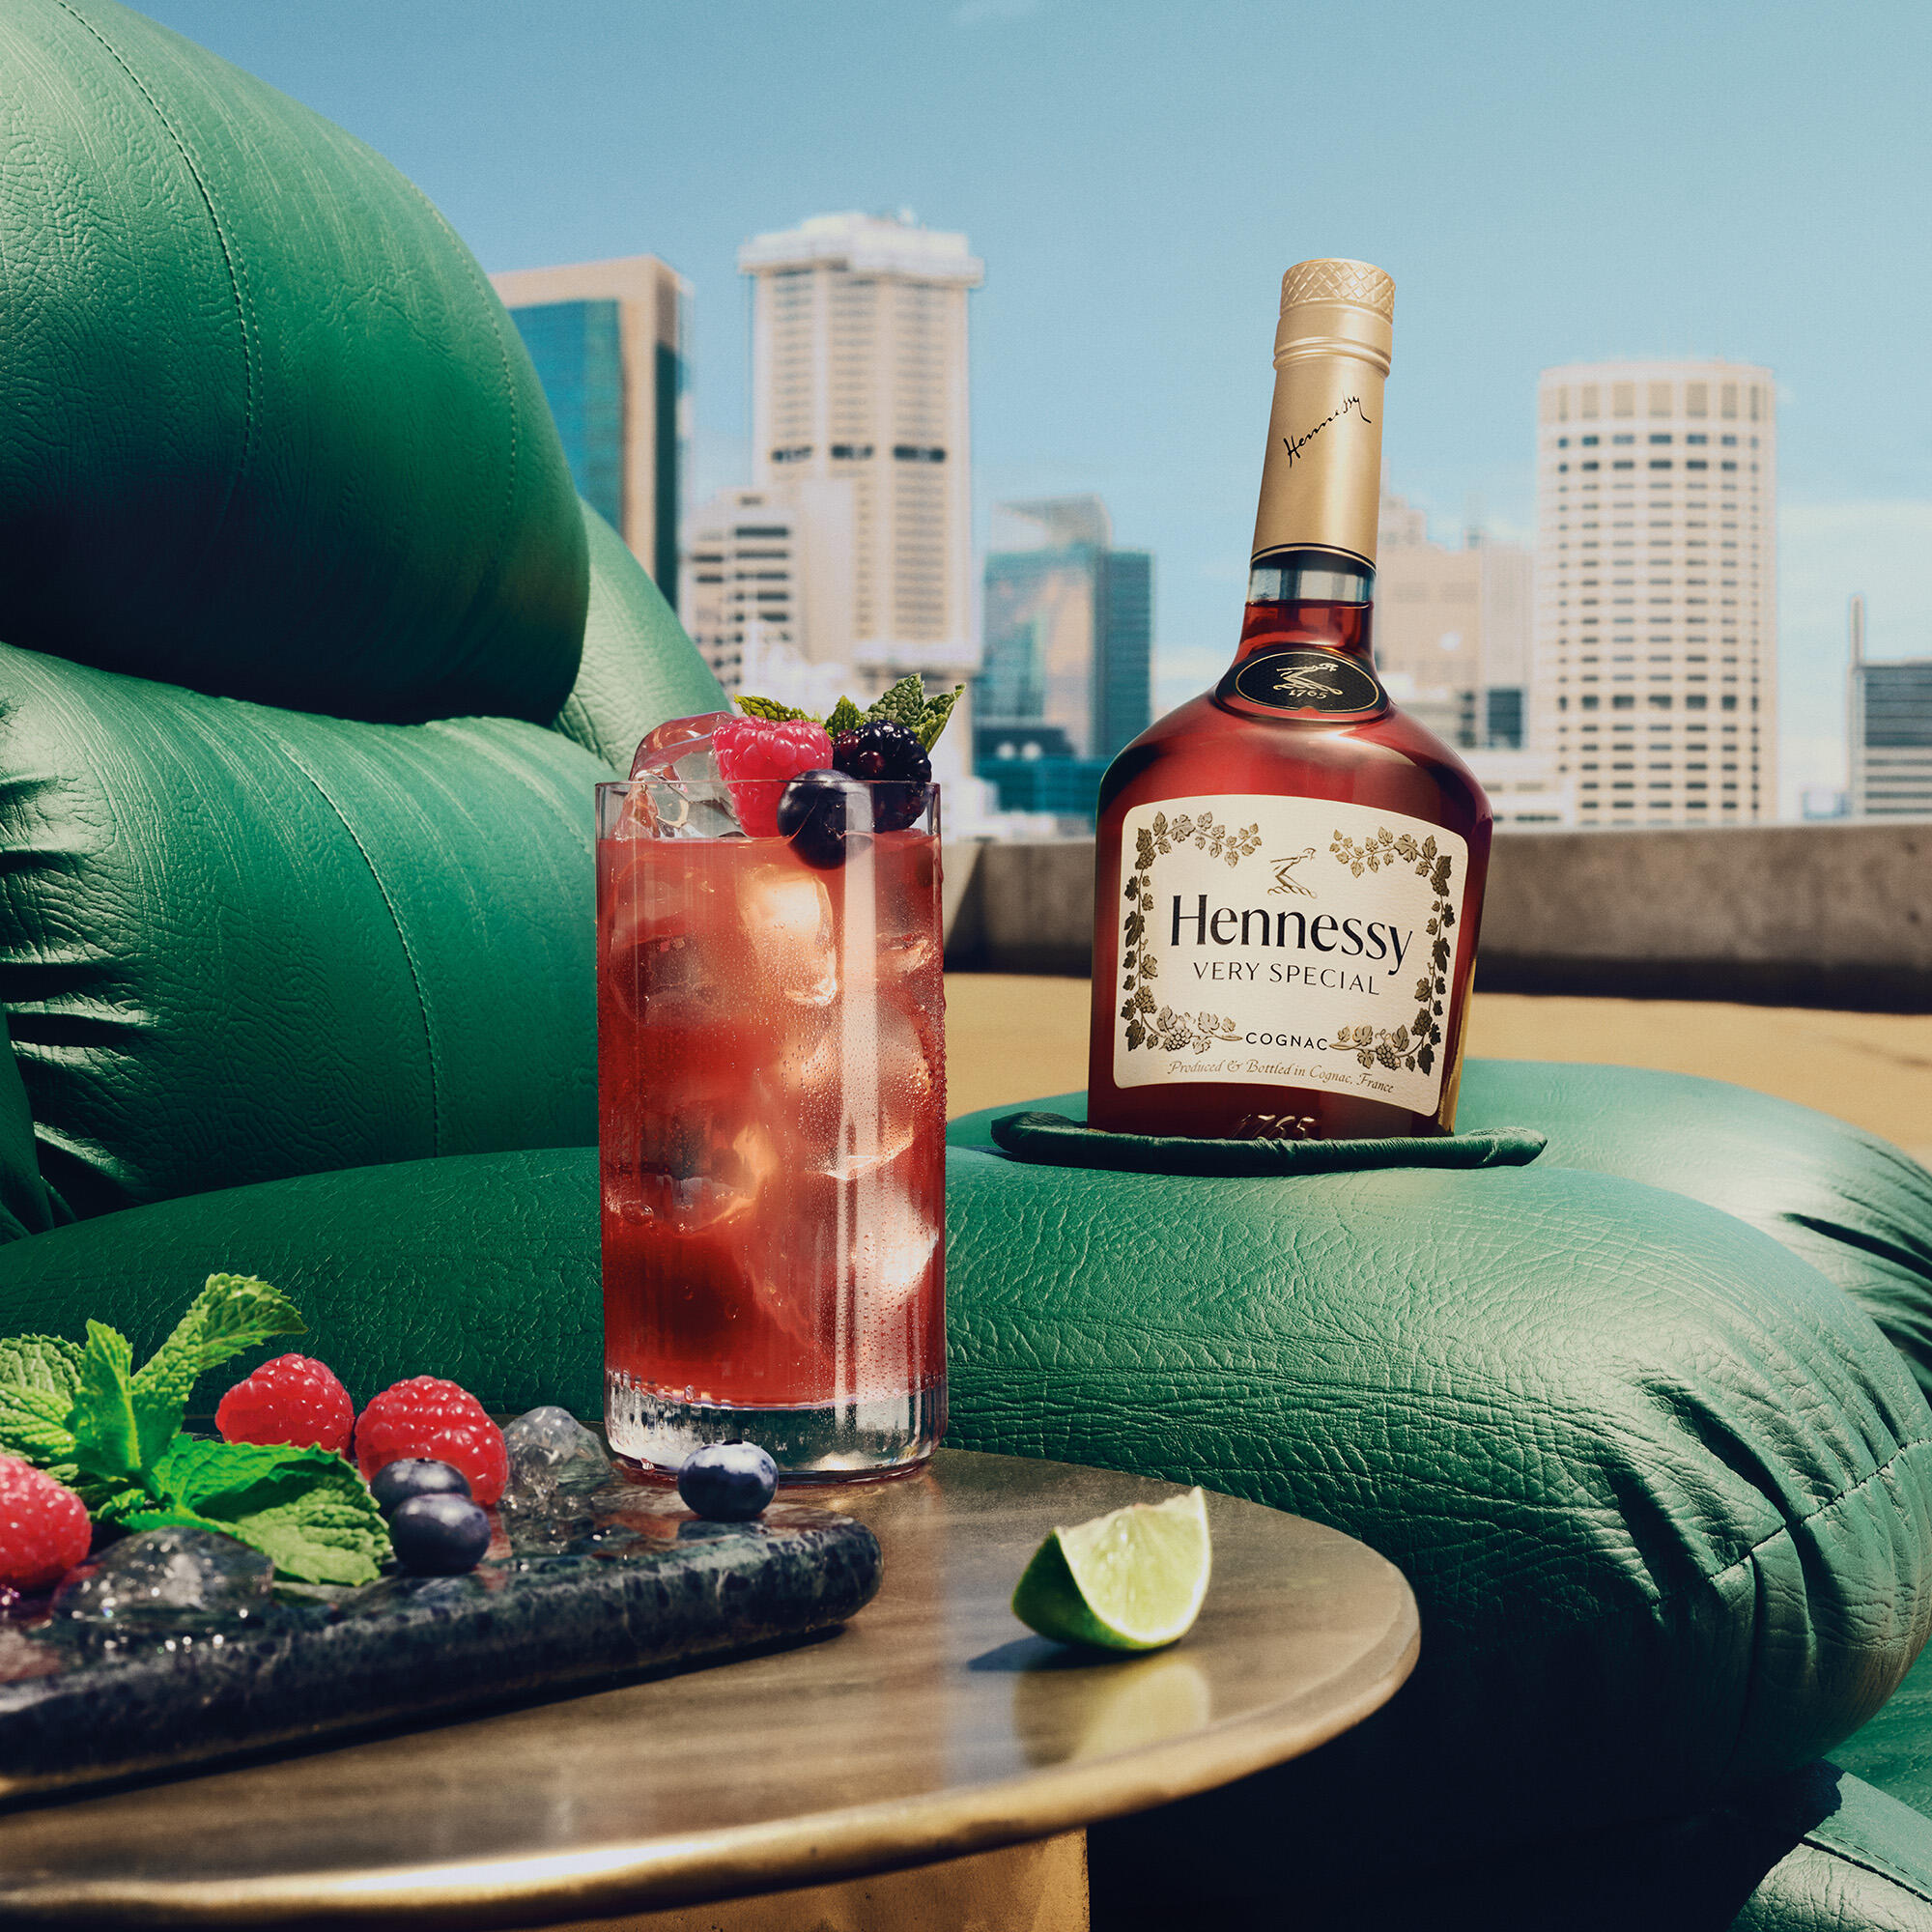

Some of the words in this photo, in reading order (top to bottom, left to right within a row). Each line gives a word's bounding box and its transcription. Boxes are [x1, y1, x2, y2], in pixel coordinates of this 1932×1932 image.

[1289, 689, 1327, 699] 1765
[1170, 894, 1413, 977] Hennessy
[1193, 961, 1260, 981] VERY
[1269, 962, 1380, 996] SPECIAL
[1245, 1032, 1328, 1051] COGNAC
[1167, 1060, 1222, 1074] Produced
[1227, 1060, 1241, 1073] &
[1246, 1059, 1292, 1076] Bottled
[1293, 1065, 1306, 1077] in
[1309, 1065, 1353, 1085] Cognac,
[1356, 1072, 1395, 1094] France
